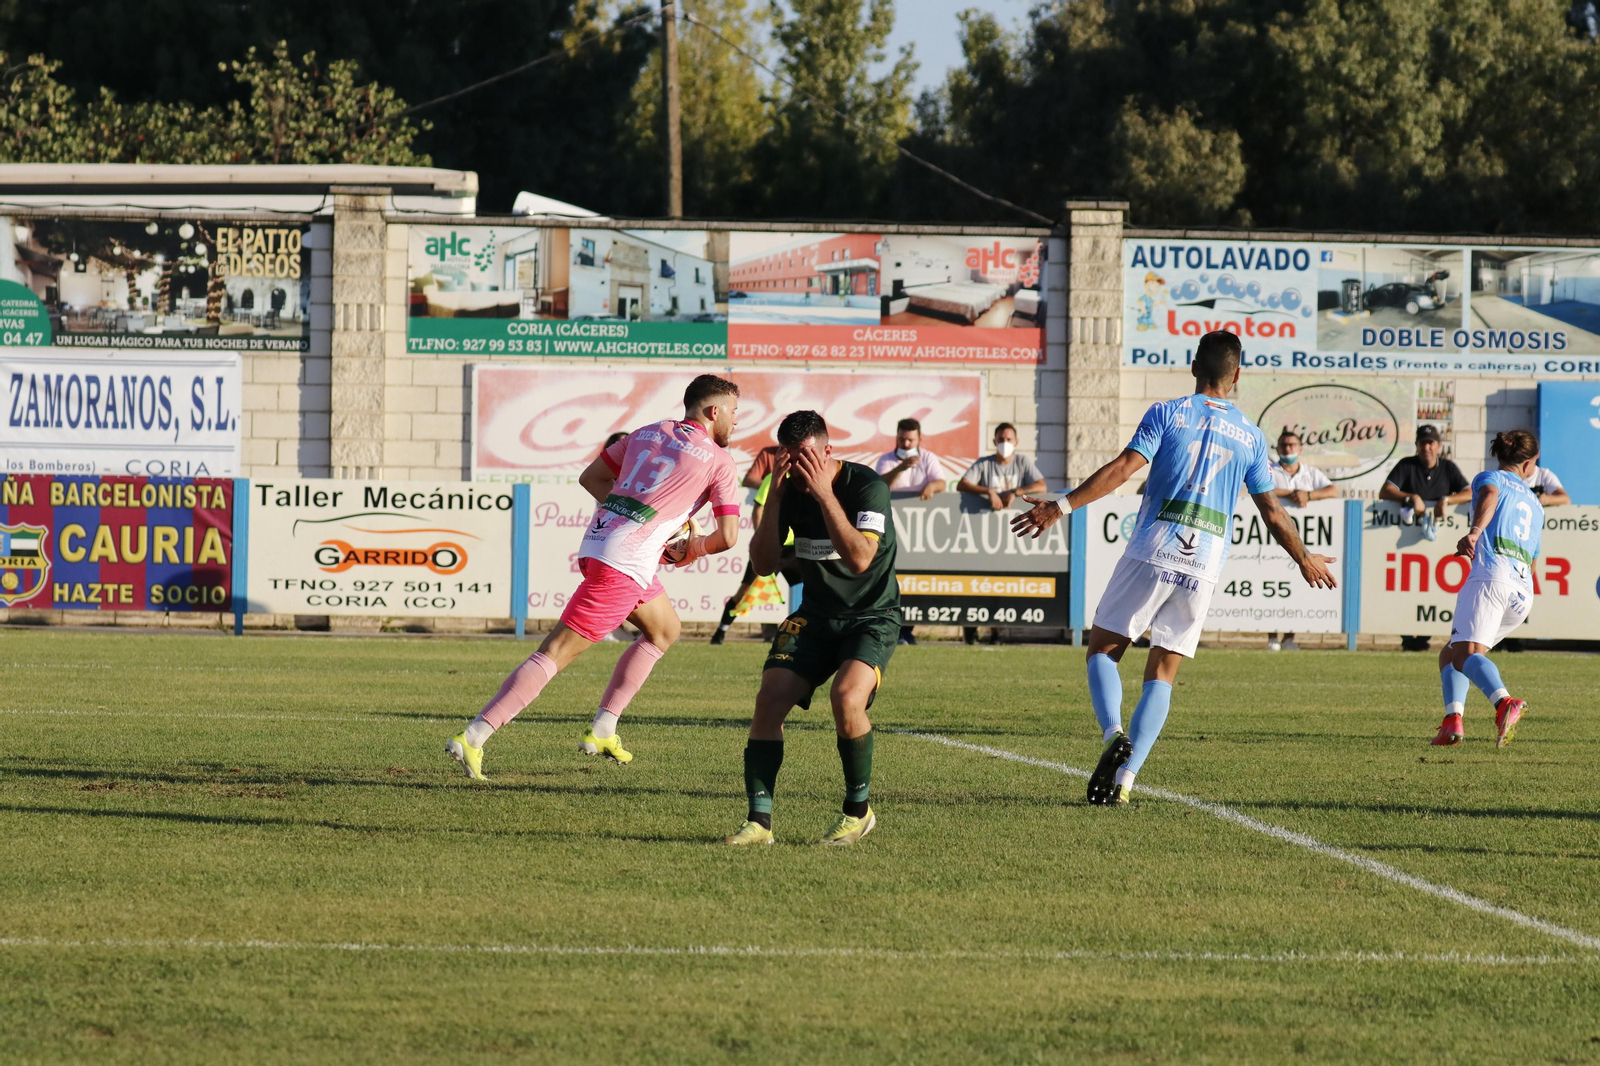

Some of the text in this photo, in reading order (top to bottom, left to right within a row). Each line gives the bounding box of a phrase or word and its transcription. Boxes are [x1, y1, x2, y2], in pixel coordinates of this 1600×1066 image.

[217, 228, 302, 254] EL PATIO
[230, 254, 302, 279] DESEOS
[1131, 245, 1311, 272] AUTOLAVADO
[1, 300, 38, 308] CATEDRAL
[3, 332, 44, 345] 04 47
[507, 322, 629, 339] CORIA (CÁCERES)
[853, 329, 917, 342] CÁCERES
[1362, 328, 1567, 351] DOBLE OSMOSIS
[56, 335, 308, 351] UN LUGAR MÁGICO PARA TUS NOCHES DE VERANO
[409, 339, 460, 351] TLFNO:
[462, 340, 487, 352] 927
[488, 340, 506, 352] 99
[507, 341, 524, 352] 53
[526, 341, 542, 353] 83
[554, 341, 726, 356] WWW.AHCHOTELES.COM
[733, 344, 783, 357] TLFNO:
[785, 345, 810, 357] 927
[811, 345, 829, 358] 62
[830, 346, 847, 358] 82
[848, 346, 866, 358] 23
[1132, 348, 1175, 365] Pol.
[1241, 350, 1282, 367] Los
[1292, 351, 1388, 369] Rosales
[1393, 359, 1448, 371] (Frente
[1454, 362, 1463, 370] a
[1468, 360, 1537, 374] cahersa)
[9, 373, 237, 443] ZAMORANOS, S.L.
[6, 459, 211, 476] los Bomberos) CORIA
[620, 449, 677, 495] 13
[1183, 440, 1235, 496] 17
[1, 476, 227, 510] ÑA BARCELONISTA
[255, 484, 514, 511] Taller Mecánico
[1514, 501, 1533, 541] 3
[59, 523, 227, 565] CAURIA
[314, 547, 458, 568] GARRIDO
[718, 557, 743, 573] 26
[53, 582, 226, 606] HAZTE SOCIO
[269, 578, 493, 593] TFNO. 927 501 141
[971, 578, 1052, 594] técnica
[1224, 580, 1292, 598] 48 55
[306, 596, 457, 610] CORIA (CC)
[928, 607, 962, 622] 927
[966, 608, 990, 622] 50
[993, 608, 1017, 622] 40
[1021, 608, 1045, 623] 40
